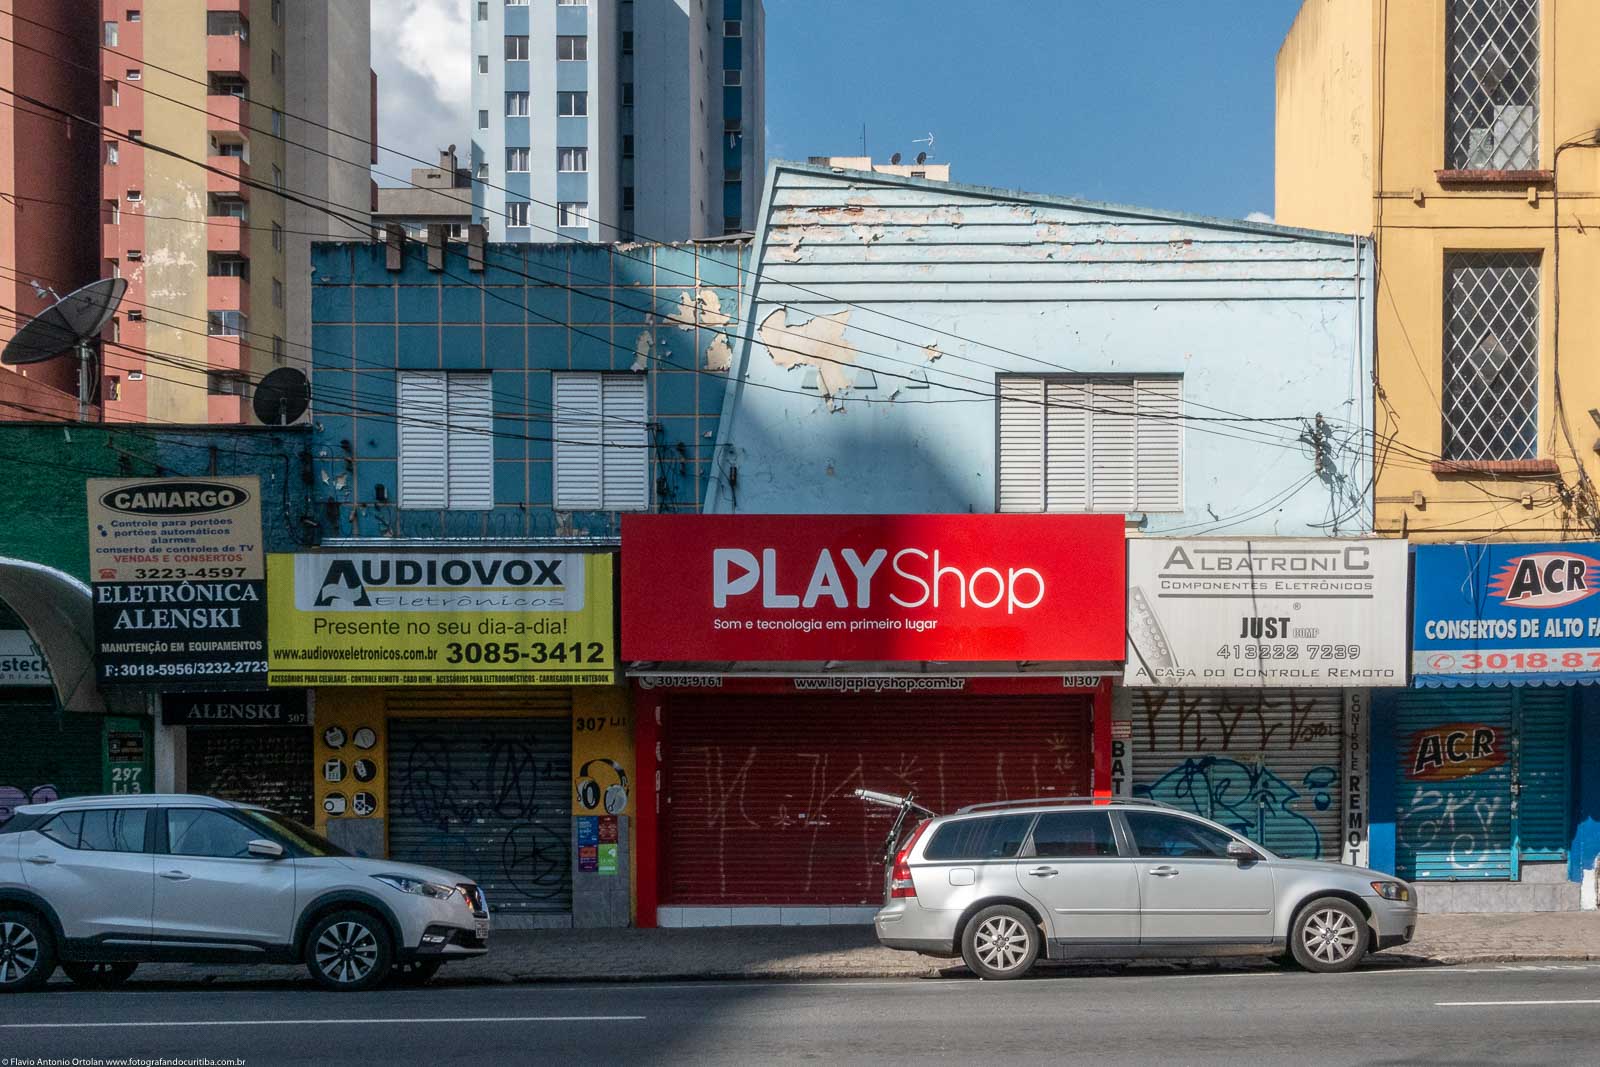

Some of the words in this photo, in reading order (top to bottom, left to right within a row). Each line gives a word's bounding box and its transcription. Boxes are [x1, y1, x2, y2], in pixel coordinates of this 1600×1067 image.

[114, 489, 236, 509] CAMARGO
[110, 520, 158, 528] Controle
[162, 521, 187, 529] para
[190, 518, 233, 528] portões
[161, 528, 230, 536] automáticos
[151, 537, 196, 545] alarmes
[96, 546, 145, 554] conserto
[166, 545, 219, 553] controles
[222, 544, 235, 552] de
[114, 555, 159, 563] VENDAS
[174, 554, 243, 562] CONSERTOS
[1163, 545, 1370, 571] ALBATRONIC
[135, 567, 247, 579] 3223-4597
[1505, 557, 1589, 601] ACR
[314, 559, 563, 607] AUDIOVOX
[1160, 579, 1268, 591] COMPONENTES
[1275, 578, 1373, 591] ELETRÔNICOS
[97, 580, 259, 604] ELETRÔNICA
[374, 595, 565, 607] Eletrônicos
[113, 608, 241, 629] ALENSKI
[314, 617, 400, 635] Presente
[408, 621, 431, 634] no
[437, 620, 472, 634] seu
[478, 618, 568, 635] dia-a-dia!
[713, 618, 742, 630] Som
[746, 621, 753, 630] e
[757, 618, 822, 633] tecnologia
[826, 621, 847, 630] em
[850, 618, 902, 633] primeiro
[905, 618, 938, 633] lugar
[1240, 617, 1290, 639] JUST
[1425, 619, 1517, 640] CONSERTOS
[1520, 618, 1539, 638] DE
[1544, 618, 1584, 638] ALTO
[101, 641, 168, 654] MANUTENÇÃO
[170, 642, 185, 651] EM
[188, 640, 263, 651] EQUIPAMENTOS
[274, 646, 438, 661] www.audiovoxeletronicos.com.br
[446, 642, 605, 664] 3085-3412
[1216, 645, 1300, 660] 413222
[1306, 645, 1361, 660] 7239
[1135, 667, 1148, 678] A
[1233, 666, 1320, 678] CONTROLE
[1327, 667, 1395, 678] REMOTO
[656, 675, 723, 687] 3014-9161
[795, 675, 965, 692] www.lojaplayshop.com.br
[1076, 675, 1101, 687] 307
[187, 703, 281, 719] ALENSKI
[576, 717, 606, 731] 307
[1351, 694, 1361, 771] CONTROLE
[1413, 727, 1495, 775] ACR
[112, 768, 142, 781] 297
